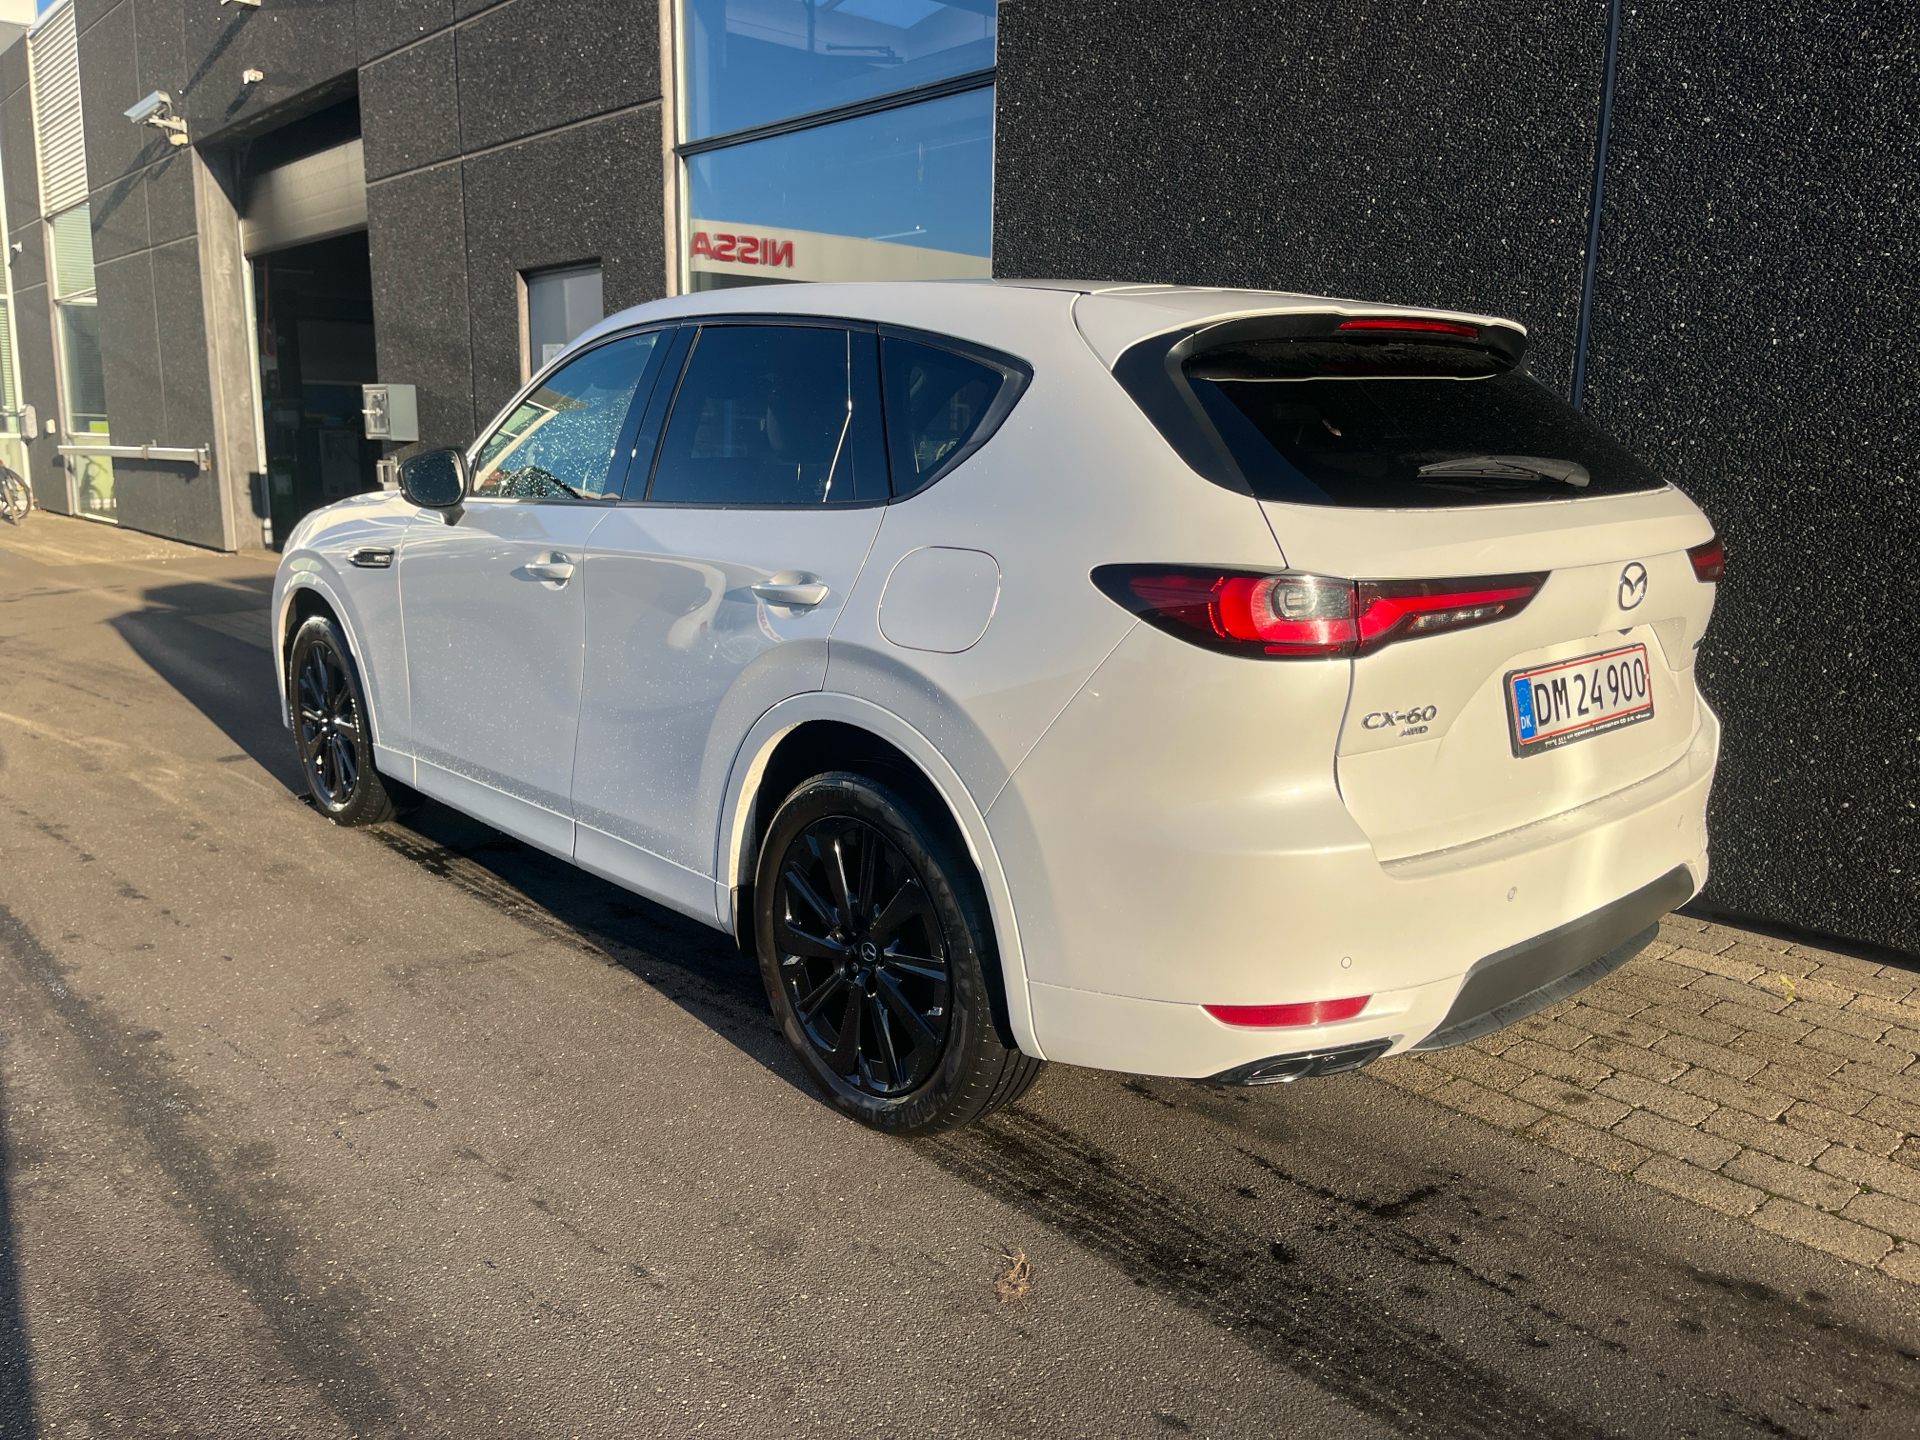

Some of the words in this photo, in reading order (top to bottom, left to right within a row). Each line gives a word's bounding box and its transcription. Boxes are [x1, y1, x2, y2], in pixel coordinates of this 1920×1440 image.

[1361, 704, 1437, 730] CX-60
[1519, 714, 1532, 730] DK
[1398, 725, 1428, 737] AWD
